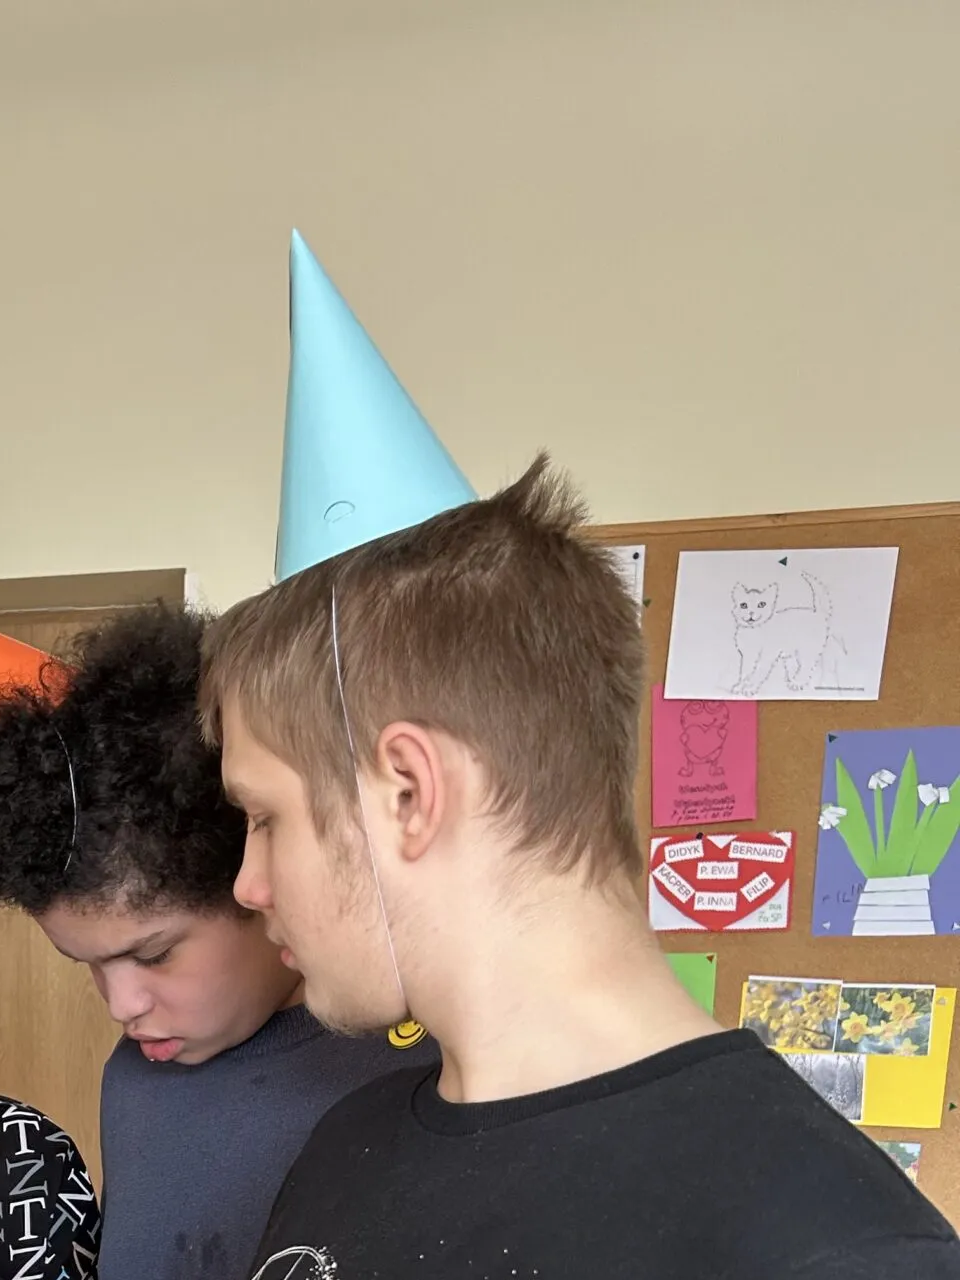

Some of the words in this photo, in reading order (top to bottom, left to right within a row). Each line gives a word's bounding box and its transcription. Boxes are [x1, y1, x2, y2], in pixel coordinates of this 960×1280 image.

[668, 844, 701, 859] DIDYK
[731, 844, 784, 859] BERNARD
[700, 866, 709, 875] P.
[711, 866, 735, 875] EWA
[657, 866, 691, 899] KACPER
[746, 876, 770, 898] FILIP
[696, 896, 705, 905] P.
[707, 896, 734, 906] INNA
